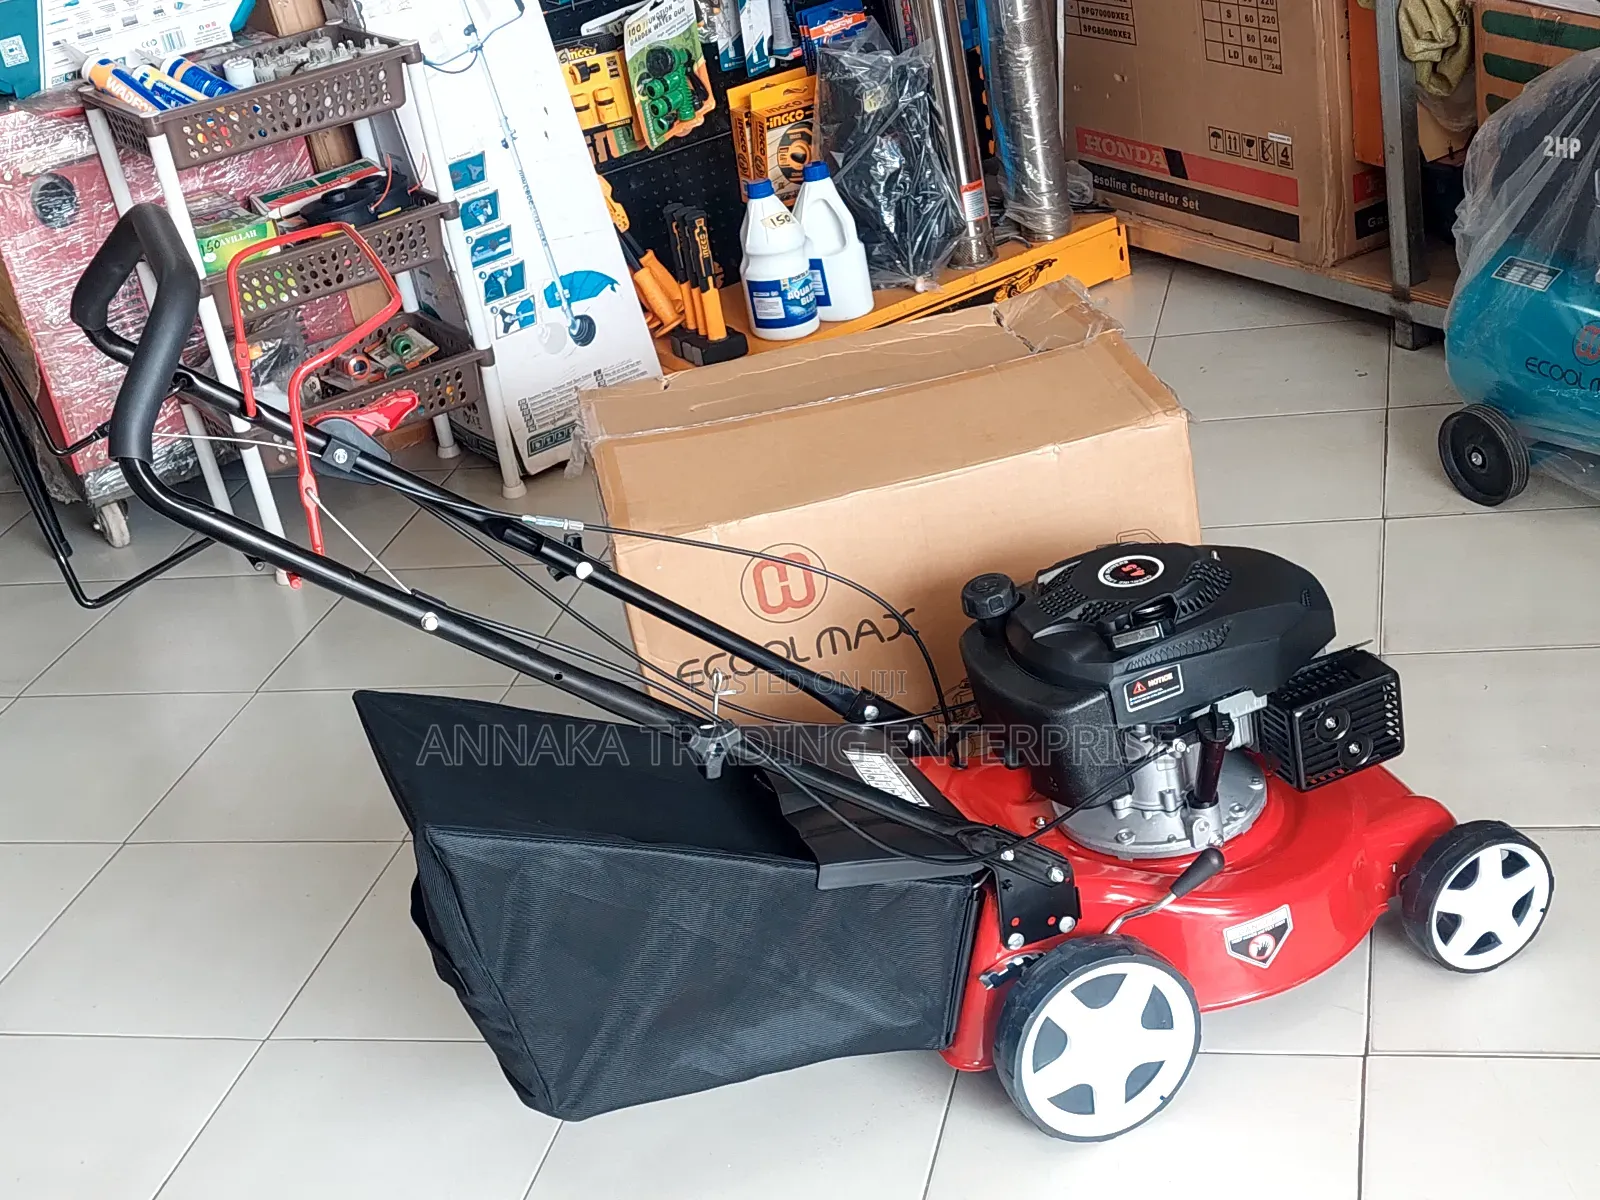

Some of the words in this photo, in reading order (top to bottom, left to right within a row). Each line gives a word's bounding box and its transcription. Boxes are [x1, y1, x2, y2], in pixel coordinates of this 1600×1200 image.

[653, 14, 672, 30] WATER
[674, 6, 686, 18] GUN
[1081, 6, 1130, 21] SPG7000DXE2
[1226, 10, 1232, 18] S
[1244, 14, 1254, 24] 60
[1262, 15, 1276, 24] 220
[1228, 28, 1234, 38] L
[1263, 34, 1278, 44] 240
[1228, 50, 1240, 60] LD
[1248, 55, 1258, 64] 60
[769, 109, 804, 128] INGCO
[1084, 133, 1168, 169] HONDA
[1543, 135, 1582, 160] 2HP
[1092, 173, 1128, 192] asoline
[1130, 182, 1179, 206] Generator
[1182, 196, 1200, 212] Set
[770, 214, 791, 227] 150
[787, 283, 811, 300] AQUA
[800, 294, 816, 306] BLU
[676, 607, 919, 687] ECOOLMAX
[1148, 672, 1174, 688] NOTICE
